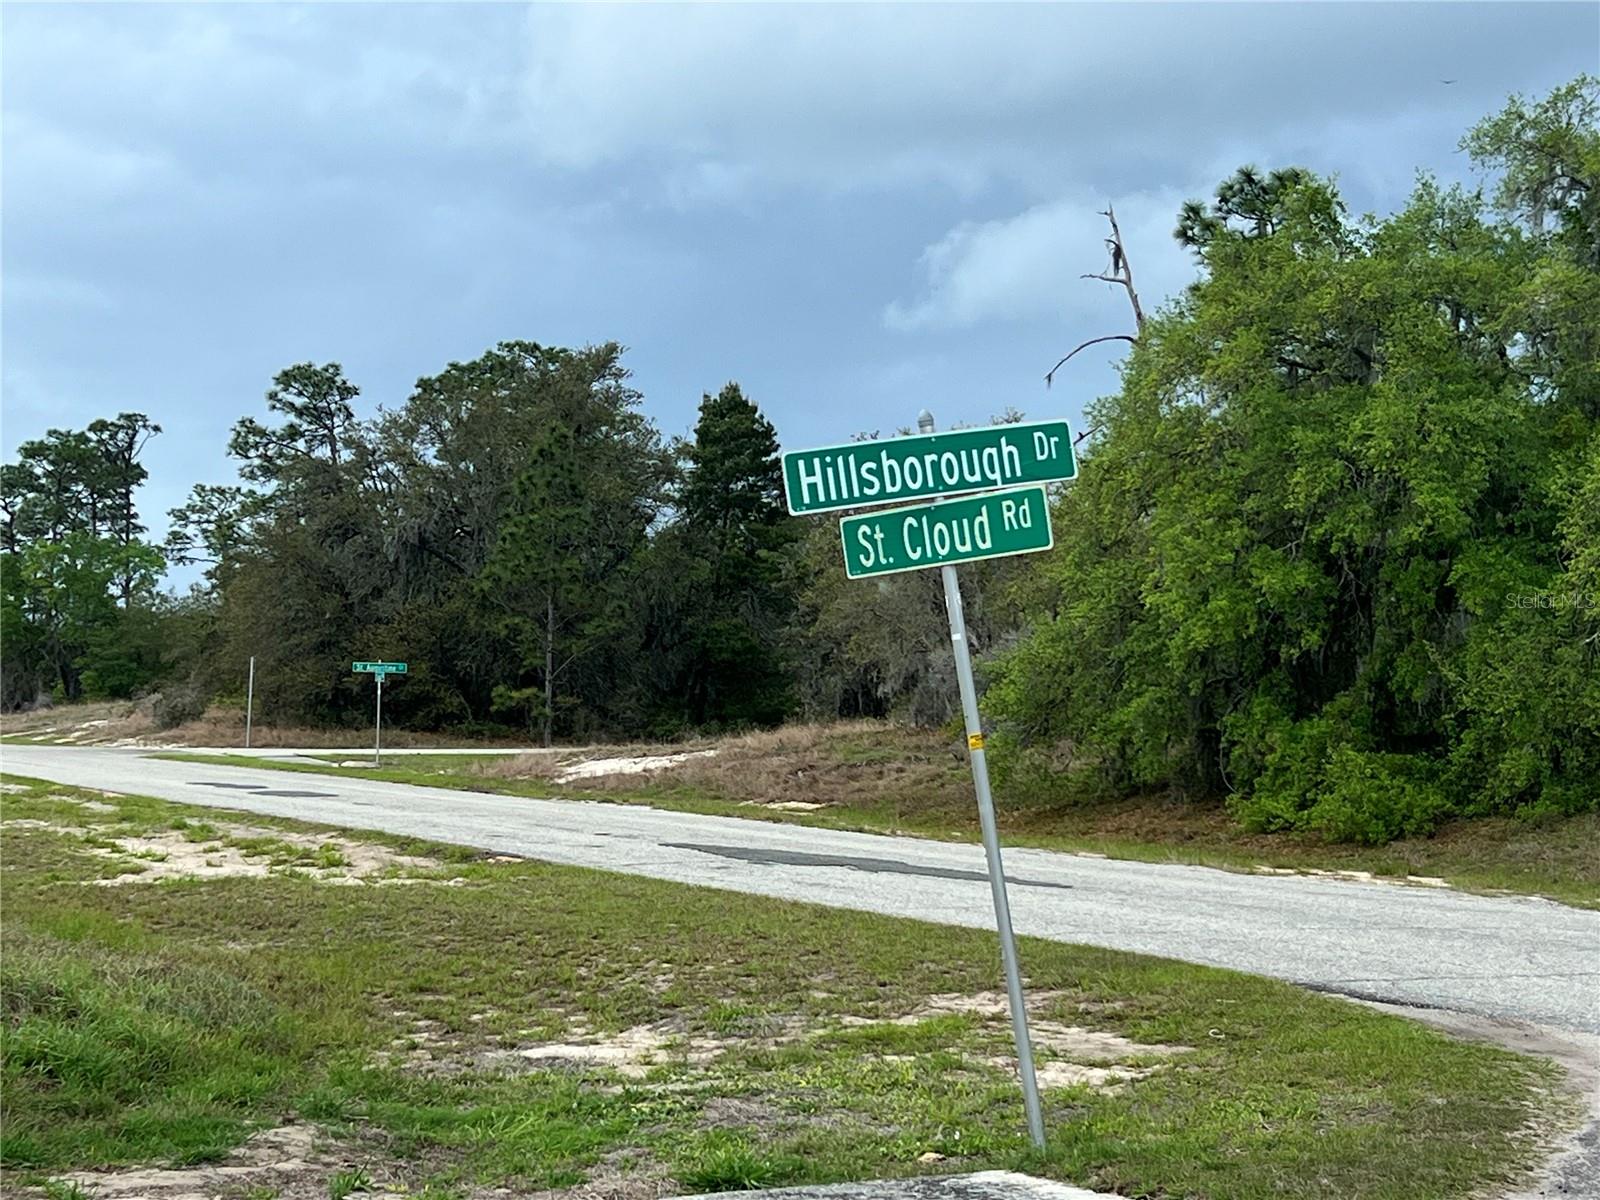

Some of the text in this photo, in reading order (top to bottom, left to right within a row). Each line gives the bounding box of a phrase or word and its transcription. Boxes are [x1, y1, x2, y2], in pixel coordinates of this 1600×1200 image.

[798, 431, 1059, 504] Hillsborough Dr
[857, 498, 1032, 568] St. Cloud Rd
